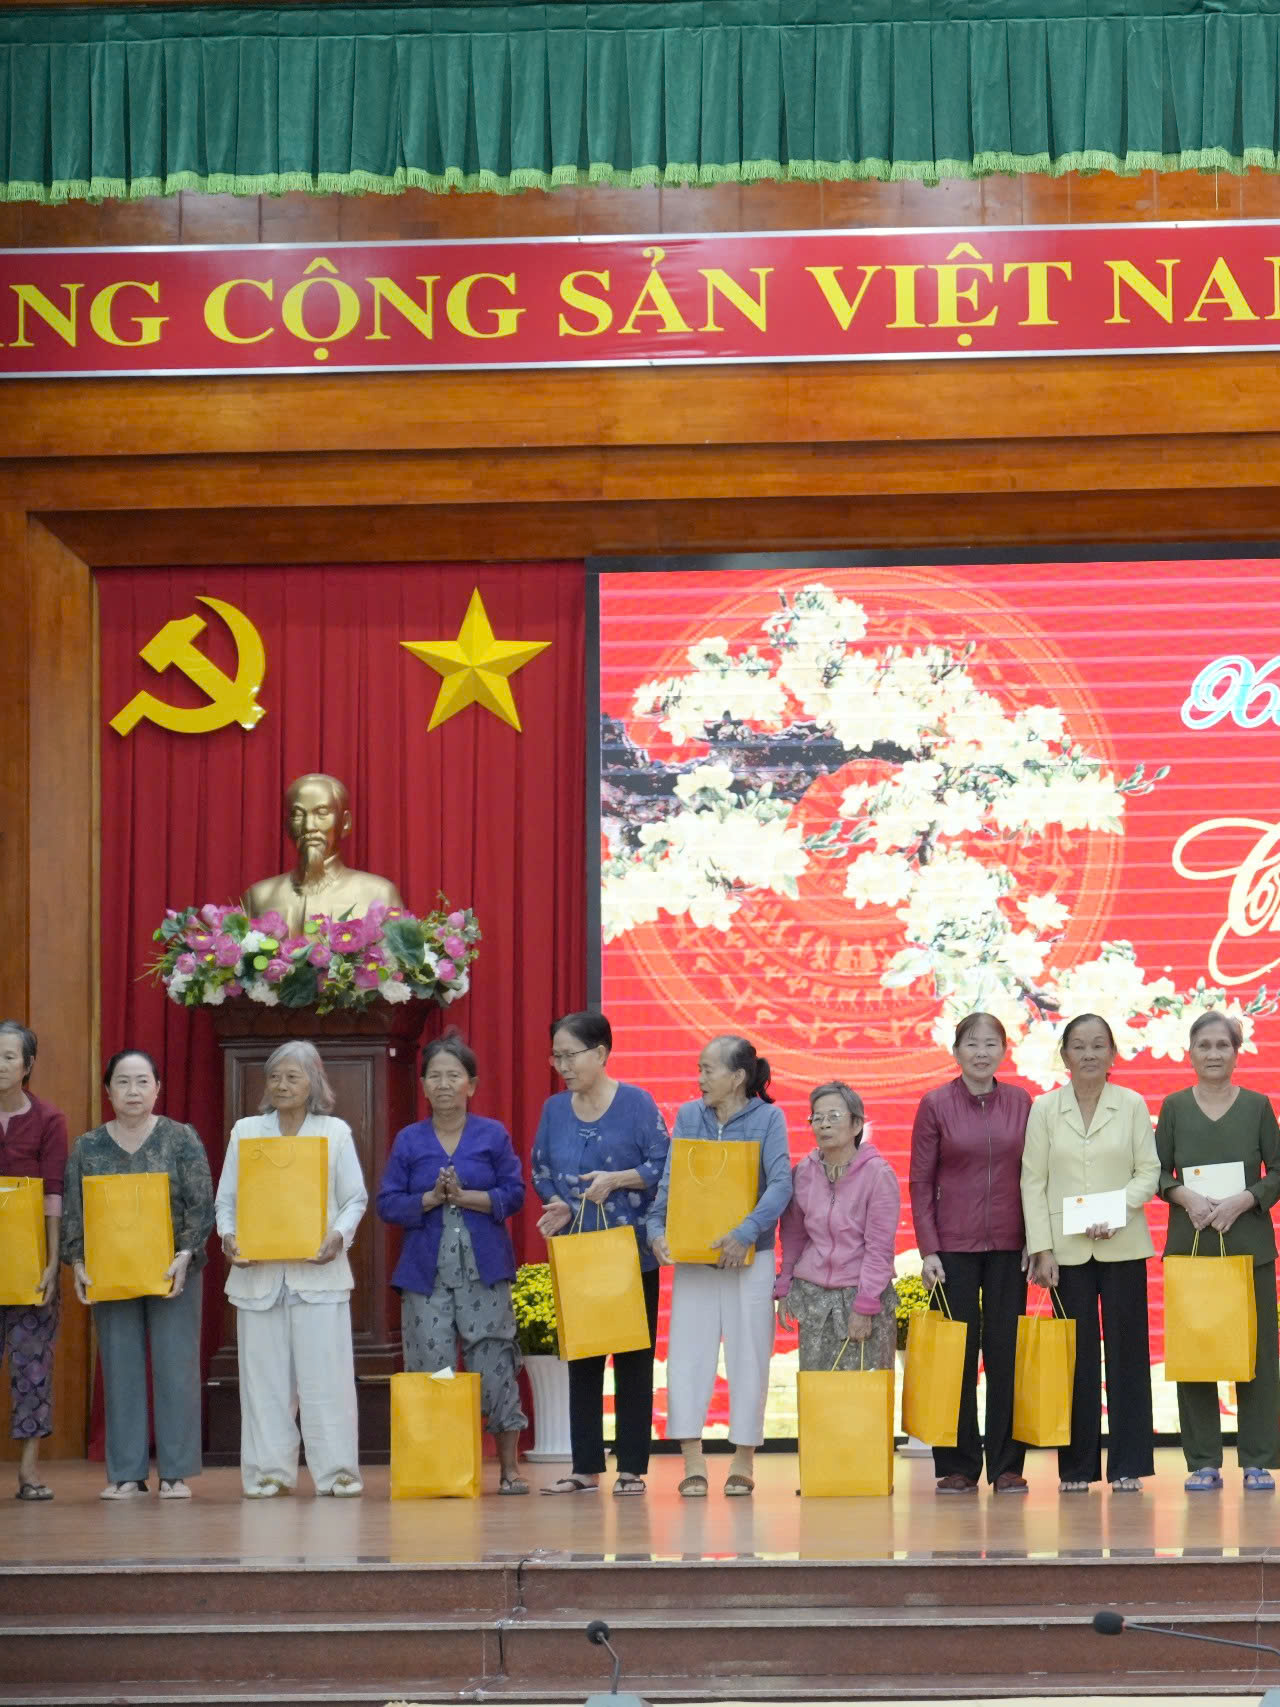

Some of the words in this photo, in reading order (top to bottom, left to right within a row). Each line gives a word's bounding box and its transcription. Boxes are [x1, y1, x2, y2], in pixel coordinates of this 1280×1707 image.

[0, 281, 170, 347] NG
[203, 256, 527, 361] CỘNG
[558, 246, 775, 336] SẢN
[805, 242, 1073, 347] VIỆT
